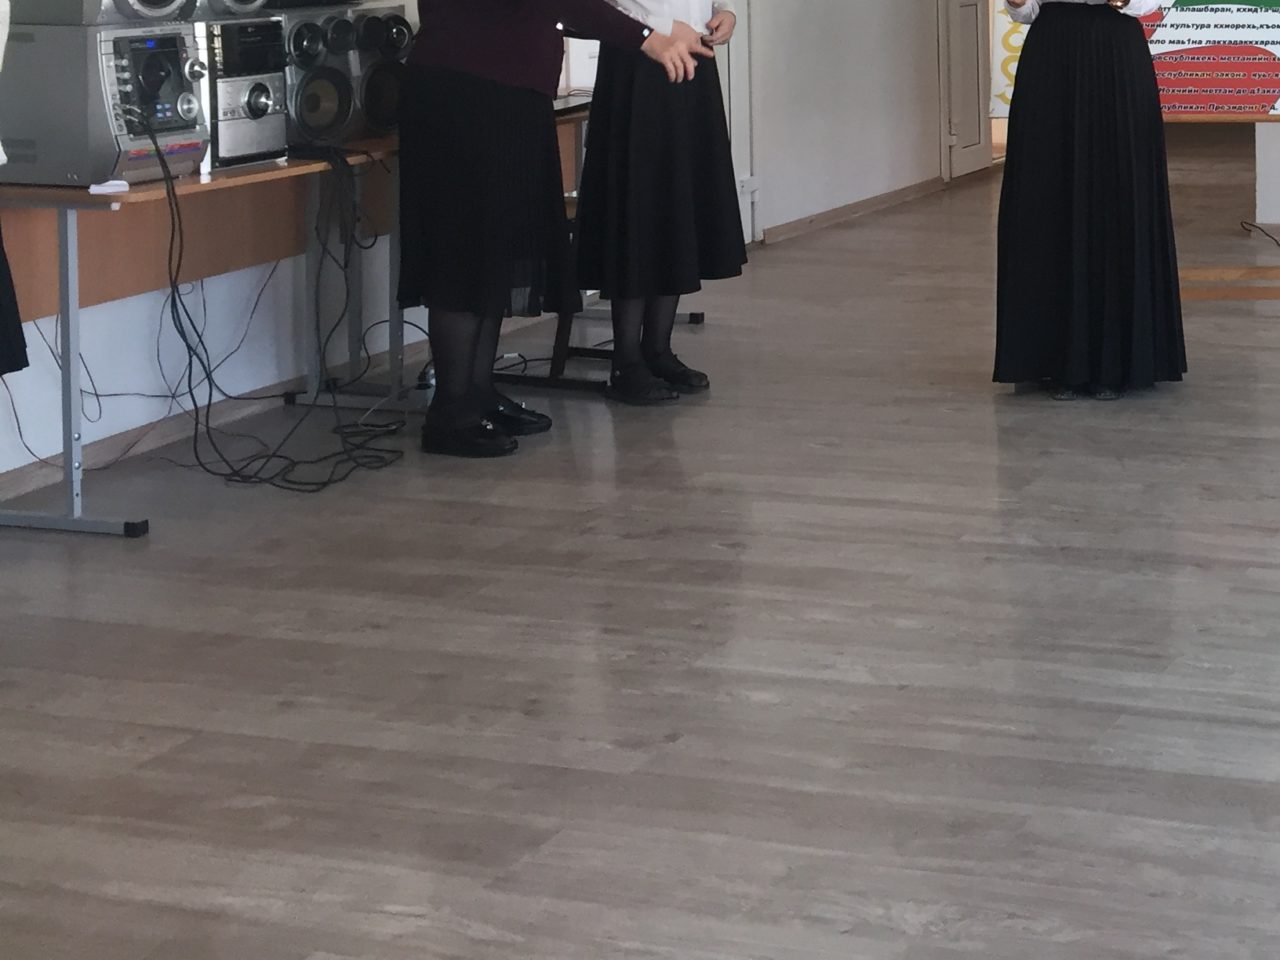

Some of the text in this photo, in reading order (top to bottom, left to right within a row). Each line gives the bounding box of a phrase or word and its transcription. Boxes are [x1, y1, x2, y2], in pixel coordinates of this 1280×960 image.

[1170, 22, 1212, 30] культура
[1155, 71, 1212, 80] еспубликан
[1160, 103, 1205, 112] публикан
